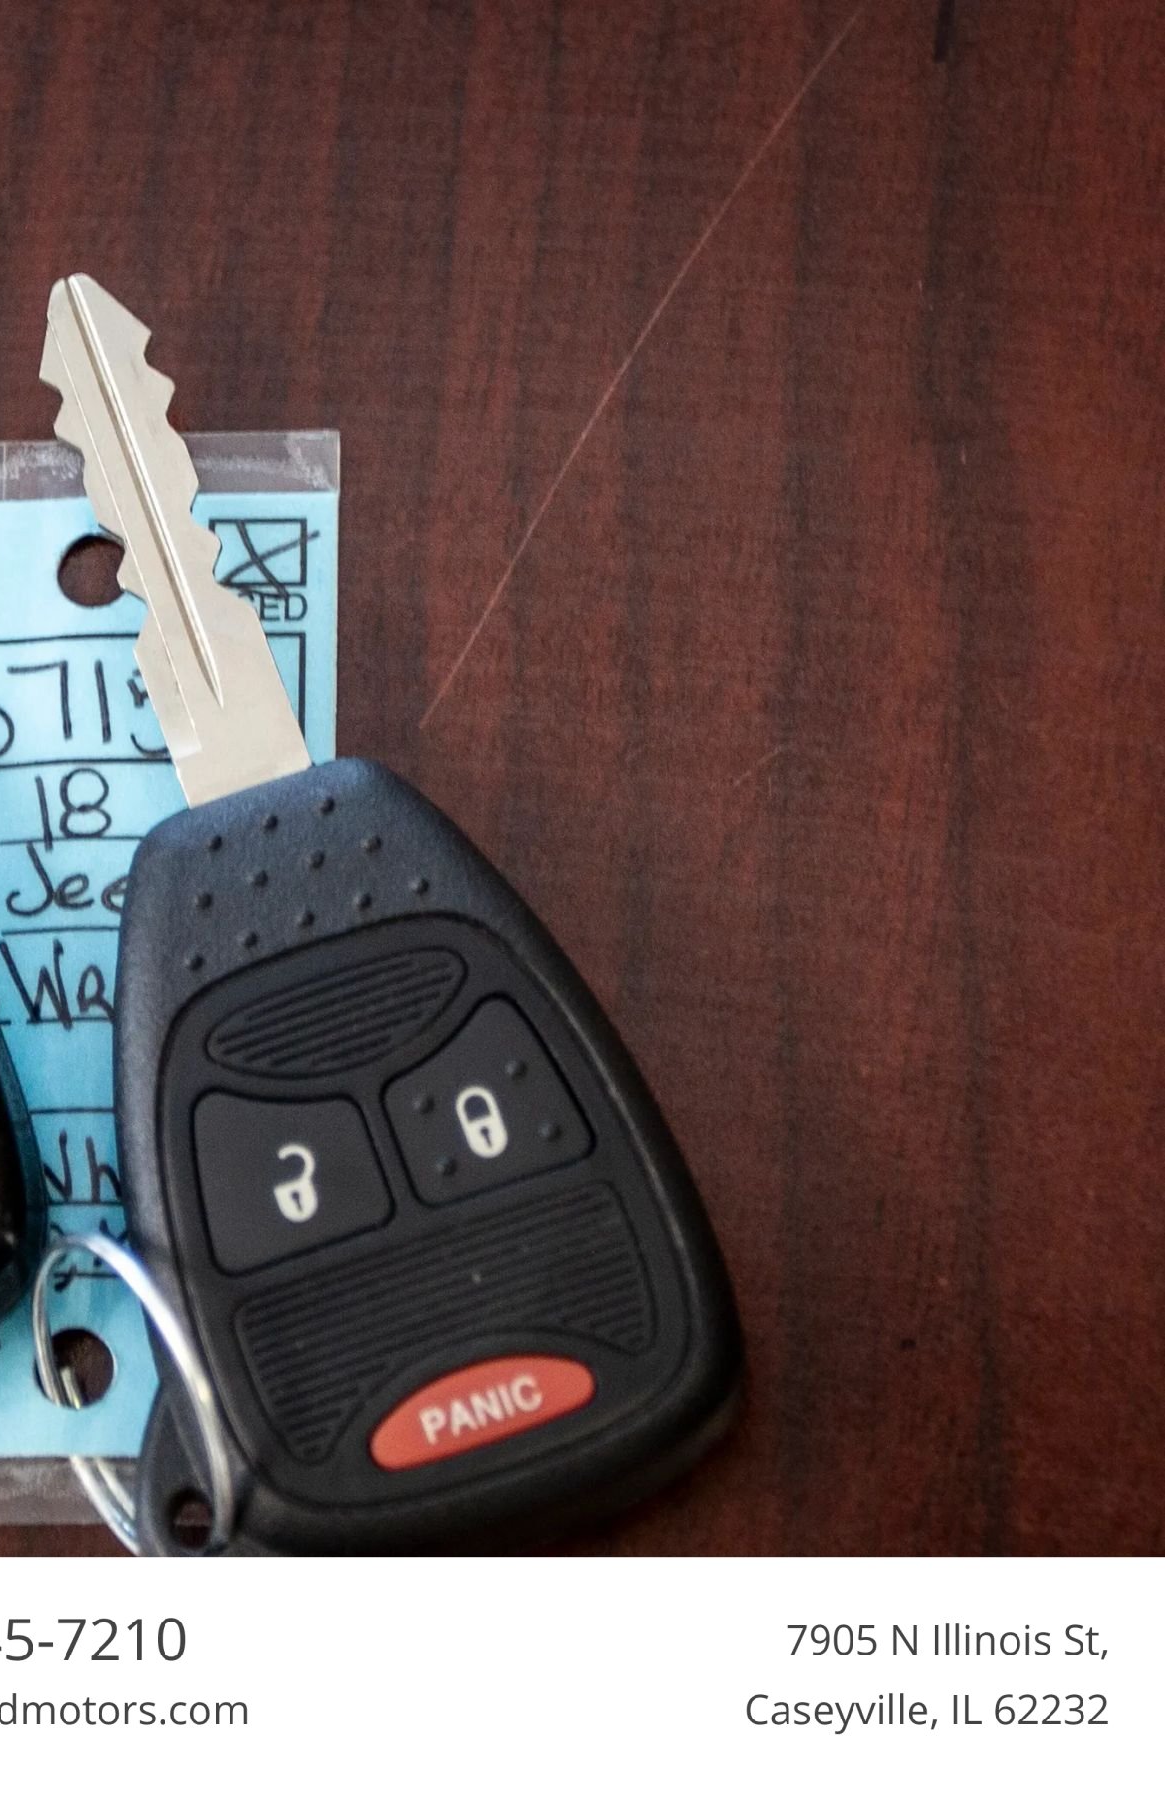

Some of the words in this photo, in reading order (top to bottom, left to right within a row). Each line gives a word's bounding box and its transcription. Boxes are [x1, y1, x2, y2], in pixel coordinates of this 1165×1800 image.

[248, 593, 309, 622] ED
[35, 767, 113, 852] 18
[5, 840, 130, 917] Jee
[419, 1374, 544, 1446] PANIC
